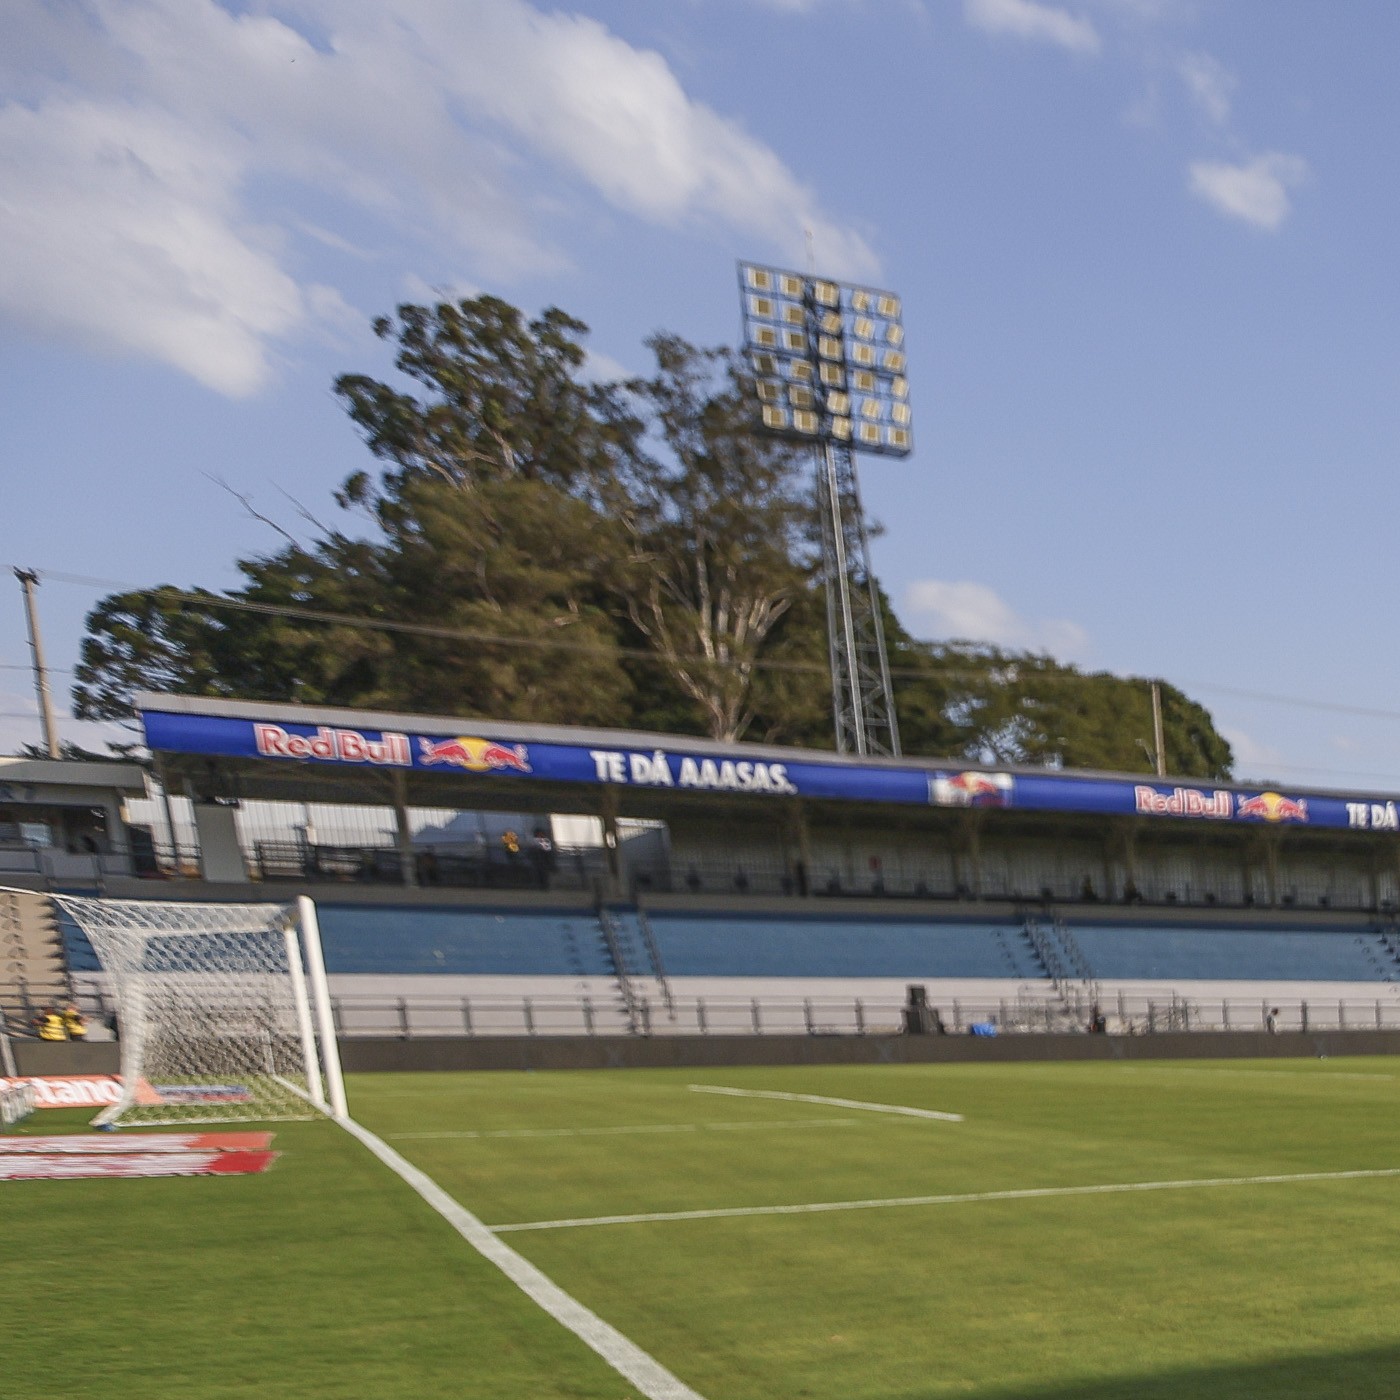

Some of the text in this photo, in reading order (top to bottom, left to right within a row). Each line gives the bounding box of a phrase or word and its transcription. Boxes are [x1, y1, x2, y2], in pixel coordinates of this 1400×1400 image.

[590, 750, 628, 784] TE
[629, 749, 675, 788] DÁ
[1345, 802, 1370, 830] TE
